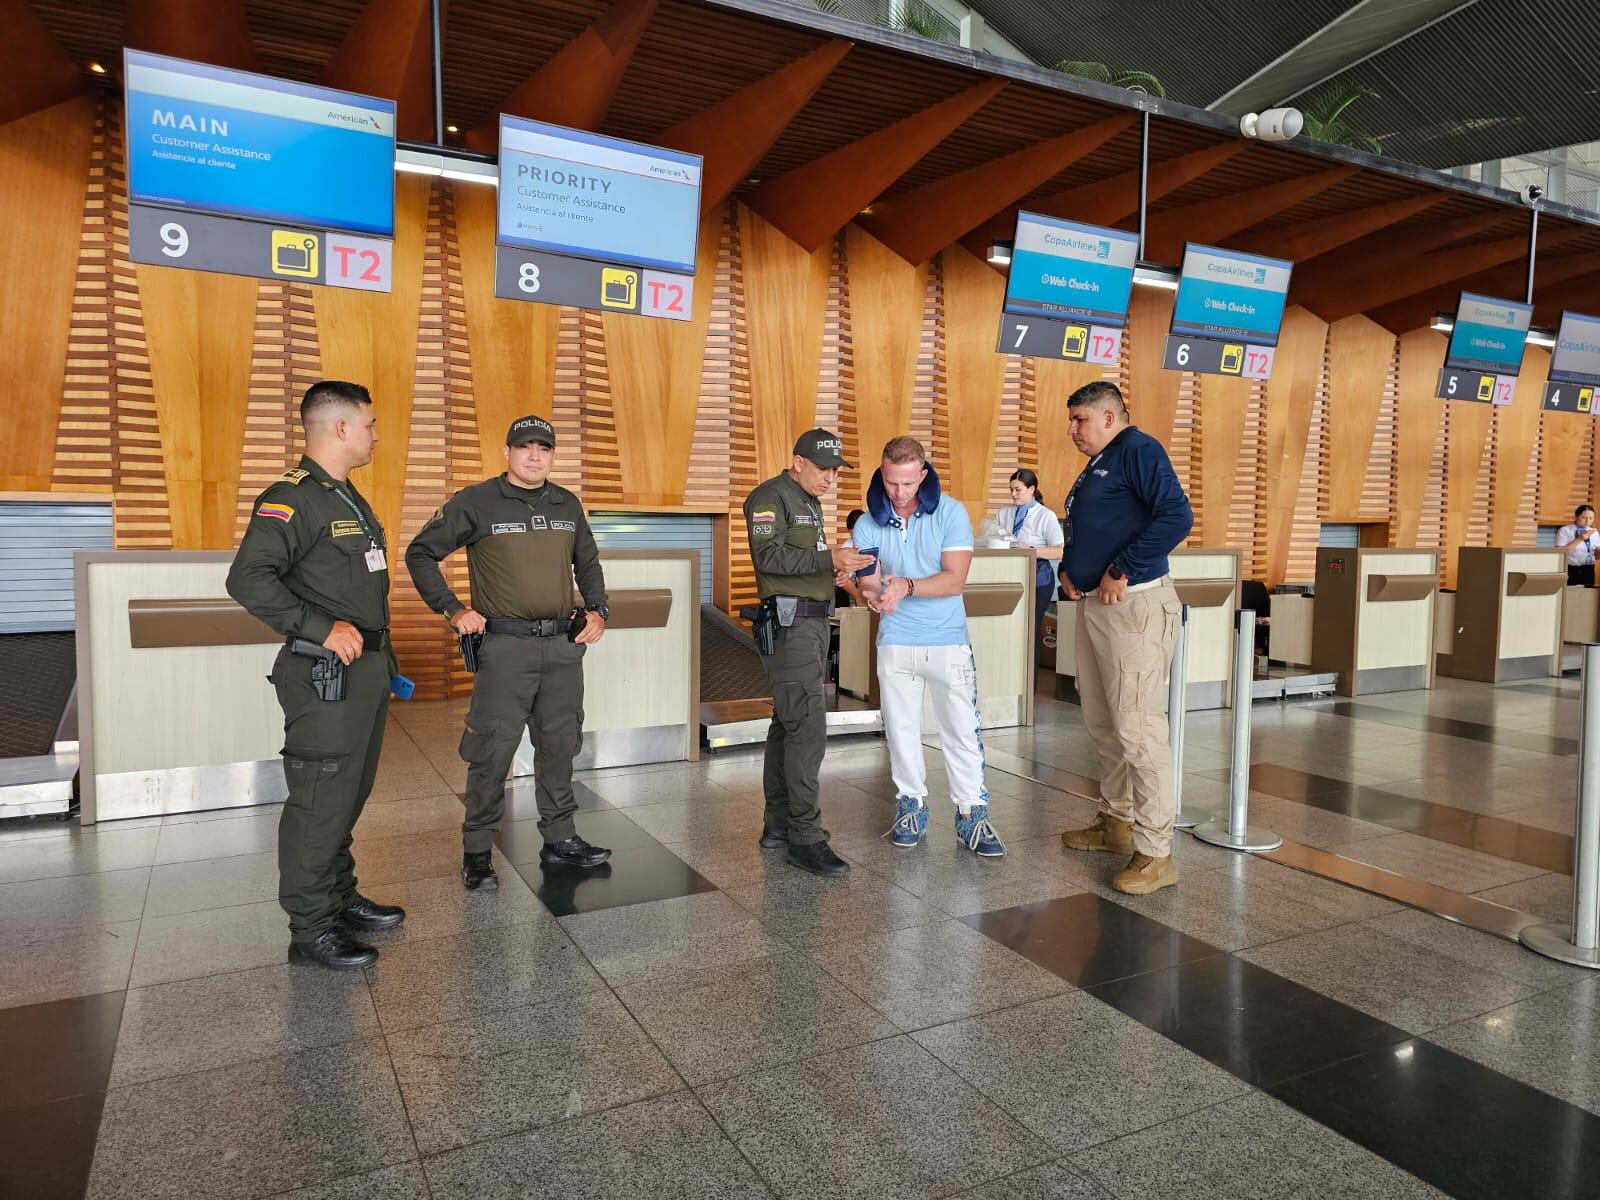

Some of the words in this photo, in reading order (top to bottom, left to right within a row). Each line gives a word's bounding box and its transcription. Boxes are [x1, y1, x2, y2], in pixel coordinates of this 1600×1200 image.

[152, 109, 228, 137] MAIN
[327, 111, 369, 126] American
[152, 133, 210, 152] Customer
[212, 143, 272, 161] Assistance
[151, 149, 196, 164] Asistencia
[197, 156, 206, 165] al
[207, 158, 237, 170] cliente
[517, 164, 612, 194] PRIORITY
[650, 165, 681, 177] American
[517, 185, 570, 205] Customer
[573, 195, 626, 214] Assistance
[516, 202, 557, 217] Asistencia
[567, 211, 594, 223] cliente
[159, 222, 189, 258] 9
[1044, 234, 1097, 252] CopaAirlines
[332, 245, 382, 282] T2
[1207, 263, 1254, 278] CopaAirlines
[518, 262, 540, 293] 8
[1050, 275, 1067, 287] Web
[647, 281, 684, 313] T2
[1211, 299, 1227, 310] Web
[1014, 324, 1029, 348] 7
[1093, 335, 1115, 359] T2
[1176, 343, 1190, 366] 6
[1248, 352, 1268, 374] T2
[1447, 376, 1459, 394] 5
[1497, 383, 1512, 400] T2
[1551, 388, 1561, 407] 4
